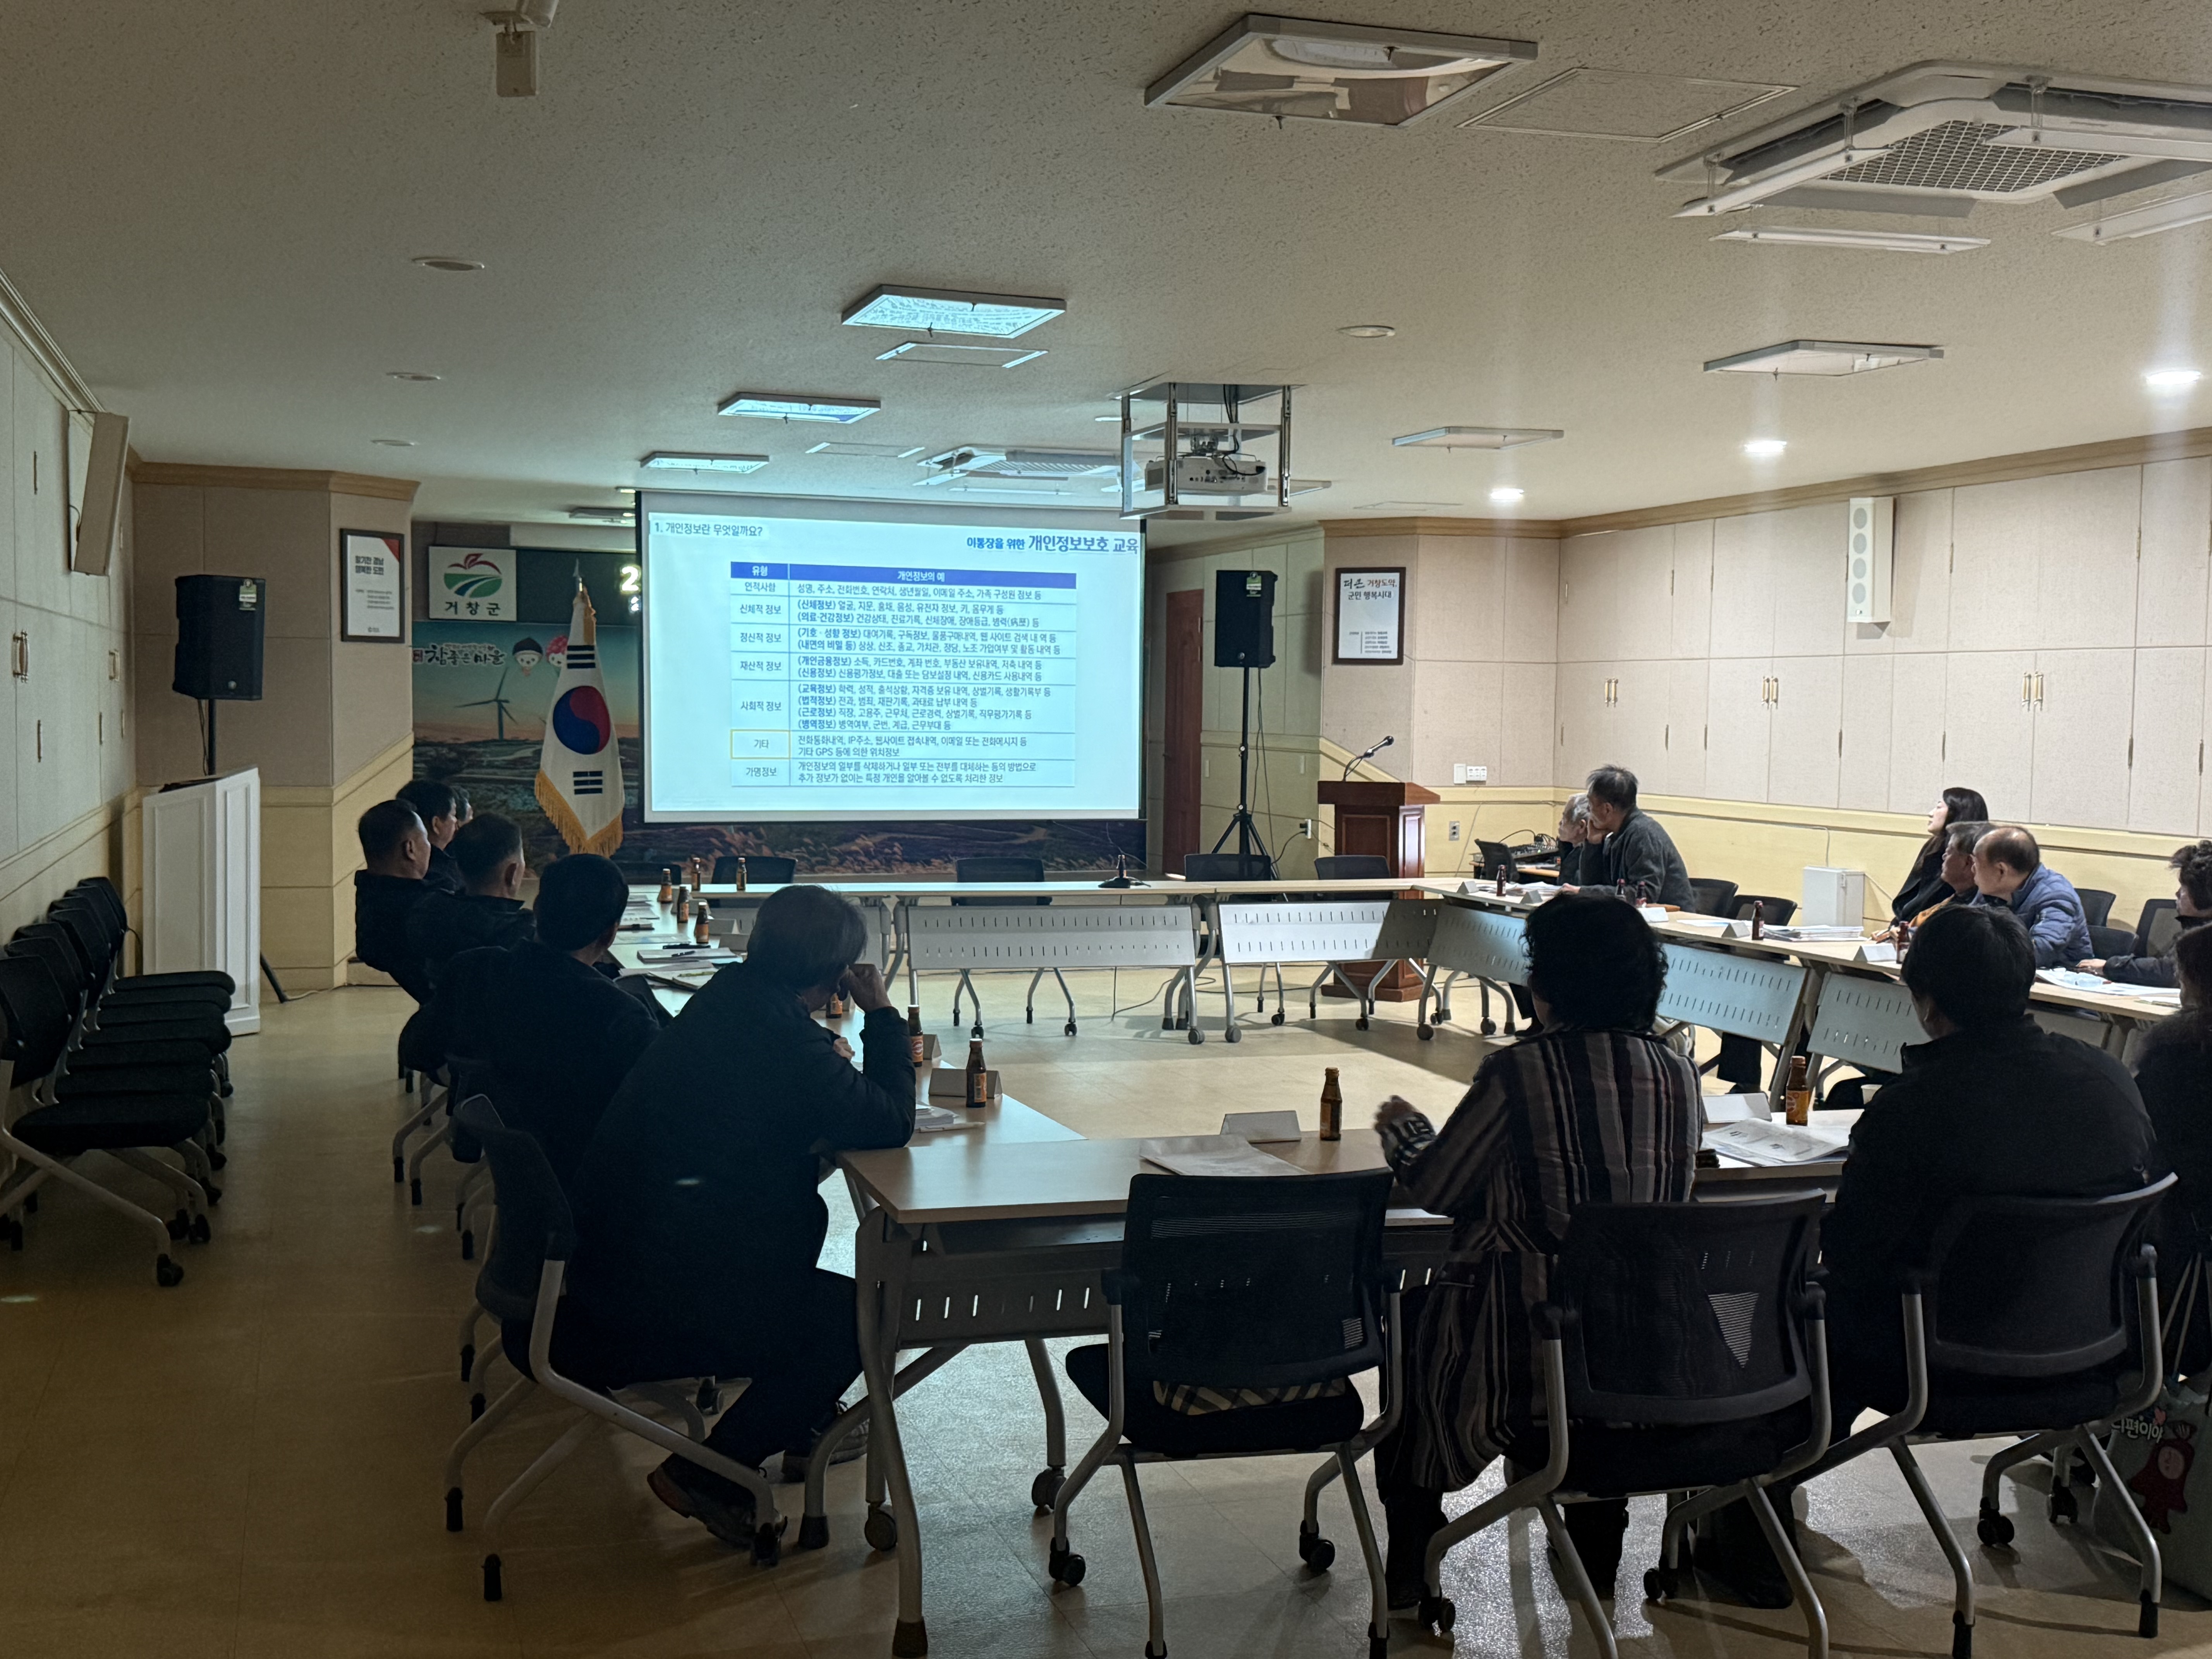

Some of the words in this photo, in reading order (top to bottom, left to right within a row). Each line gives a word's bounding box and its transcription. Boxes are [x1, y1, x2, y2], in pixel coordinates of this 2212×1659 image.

[654, 522, 663, 533] 1.
[665, 522, 711, 536] 개인정보란
[713, 524, 763, 537] 무엇일까요?
[967, 537, 1004, 550] 이통장을
[1006, 538, 1025, 550] 위한
[1028, 535, 1109, 553] 개인정보보호
[1112, 538, 1139, 555] 교육
[751, 565, 768, 577] 유형
[897, 570, 935, 582] 개인정보의
[936, 572, 945, 582] 예
[744, 581, 776, 592] 인적사항
[797, 583, 816, 594] 성명,
[817, 584, 835, 594] 주소,
[837, 584, 870, 596] 전화번호,
[871, 586, 897, 596] 연락처,
[933, 587, 955, 598] 이메일
[957, 588, 975, 599] 주소,
[976, 589, 992, 599] 가족
[993, 589, 1016, 600] 구성원
[1017, 590, 1033, 600] 정보
[1034, 591, 1042, 601] 등
[1348, 592, 1361, 600] 군민
[1364, 591, 1392, 600] 행복시대
[739, 604, 763, 615] 신체적
[765, 605, 781, 615] 정보
[797, 599, 836, 610] (신체정보)
[838, 600, 856, 611] 얼굴,
[858, 601, 876, 612] 지문,
[897, 602, 915, 613] 음성,
[916, 603, 939, 613] 유전자
[941, 603, 958, 614] 정보,
[960, 604, 970, 615] 키,
[996, 605, 1004, 615] 등
[856, 613, 889, 624] 건강상태,
[890, 614, 923, 625] 진료기록,
[925, 615, 957, 626] 신체장애,
[958, 616, 991, 627] 장애등급,
[1032, 618, 1039, 628] 등
[740, 632, 764, 643] 정신적
[765, 632, 782, 644] 정보
[842, 628, 862, 639] 정보)
[863, 629, 896, 640] 대여기록,
[898, 629, 930, 641] 구독정보,
[989, 632, 1012, 642] 사이트
[1013, 632, 1029, 643] 검색
[1030, 633, 1038, 643] 내
[1039, 633, 1047, 643] 역
[1049, 633, 1056, 644] 등
[797, 639, 825, 650] (내면의
[845, 640, 857, 651] 등)
[858, 641, 876, 652] 상상,
[878, 641, 896, 652] 신조,
[917, 642, 942, 653] 가치관,
[943, 642, 961, 653] 정당,
[962, 643, 978, 653] 노조
[979, 643, 1009, 654] 가입여부
[1010, 644, 1018, 654] 및
[1036, 644, 1051, 655] 내역
[1053, 645, 1060, 655] 등
[740, 660, 764, 672] 재산적
[766, 661, 782, 672] 정보
[854, 656, 872, 668] 소득,
[873, 657, 906, 668] 카드번호,
[924, 658, 942, 669] 번호,
[944, 658, 967, 669] 부동산
[968, 659, 1000, 670] 보유내역,
[1017, 660, 1033, 670] 내역
[1034, 660, 1042, 670] 등
[797, 667, 836, 678] (신용정보)
[905, 669, 921, 680] 또는
[922, 670, 952, 681] 담보설정
[953, 670, 971, 681] 내역,
[972, 670, 1002, 681] 신용카드
[1003, 671, 1033, 682] 사용내역
[1034, 672, 1042, 682] 등
[798, 683, 836, 694] (교육정보)
[838, 684, 857, 695] 학력,
[858, 684, 876, 695] 성적,
[912, 685, 935, 696] 자격증
[936, 685, 951, 696] 보유
[952, 686, 970, 697] 내역,
[972, 686, 1004, 697] 상벌기록,
[1005, 687, 1042, 697] 생활기록부
[1043, 687, 1051, 697] 등
[740, 701, 764, 711] 사회적
[766, 701, 782, 712] 정보
[798, 695, 836, 706] (법적정보)
[838, 696, 857, 707] 전과,
[858, 696, 876, 707] 범죄,
[877, 696, 910, 708] 재판기록,
[936, 697, 951, 708] 납부
[952, 697, 968, 708] 내역
[970, 697, 977, 708] 등
[798, 707, 836, 718] (근로정보)
[838, 708, 856, 718] 직장,
[858, 708, 883, 718] 고용주,
[884, 708, 910, 719] 근무처,
[911, 708, 944, 719] 근로경력,
[945, 709, 977, 720] 상벌기록,
[979, 709, 1023, 720] 직무평가기록
[1024, 709, 1032, 720] 등
[798, 719, 836, 730] (병역정보)
[838, 720, 871, 730] 병역여부,
[872, 720, 891, 730] 군번,
[892, 720, 910, 731] 계급,
[912, 720, 942, 730] 근무부대
[943, 720, 951, 731] 등
[753, 739, 769, 749] 기타
[848, 735, 874, 746] IP주소,
[907, 736, 939, 747] 접속내역,
[941, 736, 963, 747] 이메일
[965, 736, 980, 747] 또는
[981, 736, 1018, 747] 전화메시지
[1020, 737, 1027, 747] 등
[798, 747, 814, 757] 기타
[815, 747, 834, 757] GPS
[835, 747, 851, 757] 등에
[852, 747, 868, 757] 의한
[869, 747, 900, 757] 위치정보
[745, 767, 777, 778] 가명정보
[798, 761, 836, 772] 개인정보의
[838, 761, 861, 772] 일부를
[863, 761, 901, 772] 삭제하거나
[902, 761, 918, 772] 일부
[919, 762, 935, 772] 또는
[936, 762, 958, 772] 전부를
[960, 762, 990, 772] 대체하는
[991, 762, 1006, 772] 등의
[1007, 762, 1037, 772] 방법으로
[798, 773, 814, 783] 추가
[816, 773, 839, 783] 정보가
[840, 773, 864, 783] 없이는
[882, 773, 905, 783] 개인을
[907, 773, 929, 783] 알아볼
[931, 773, 939, 783] 수
[940, 773, 963, 783] 없도록
[964, 773, 987, 783] 처리한
[988, 773, 1003, 783] 정보
